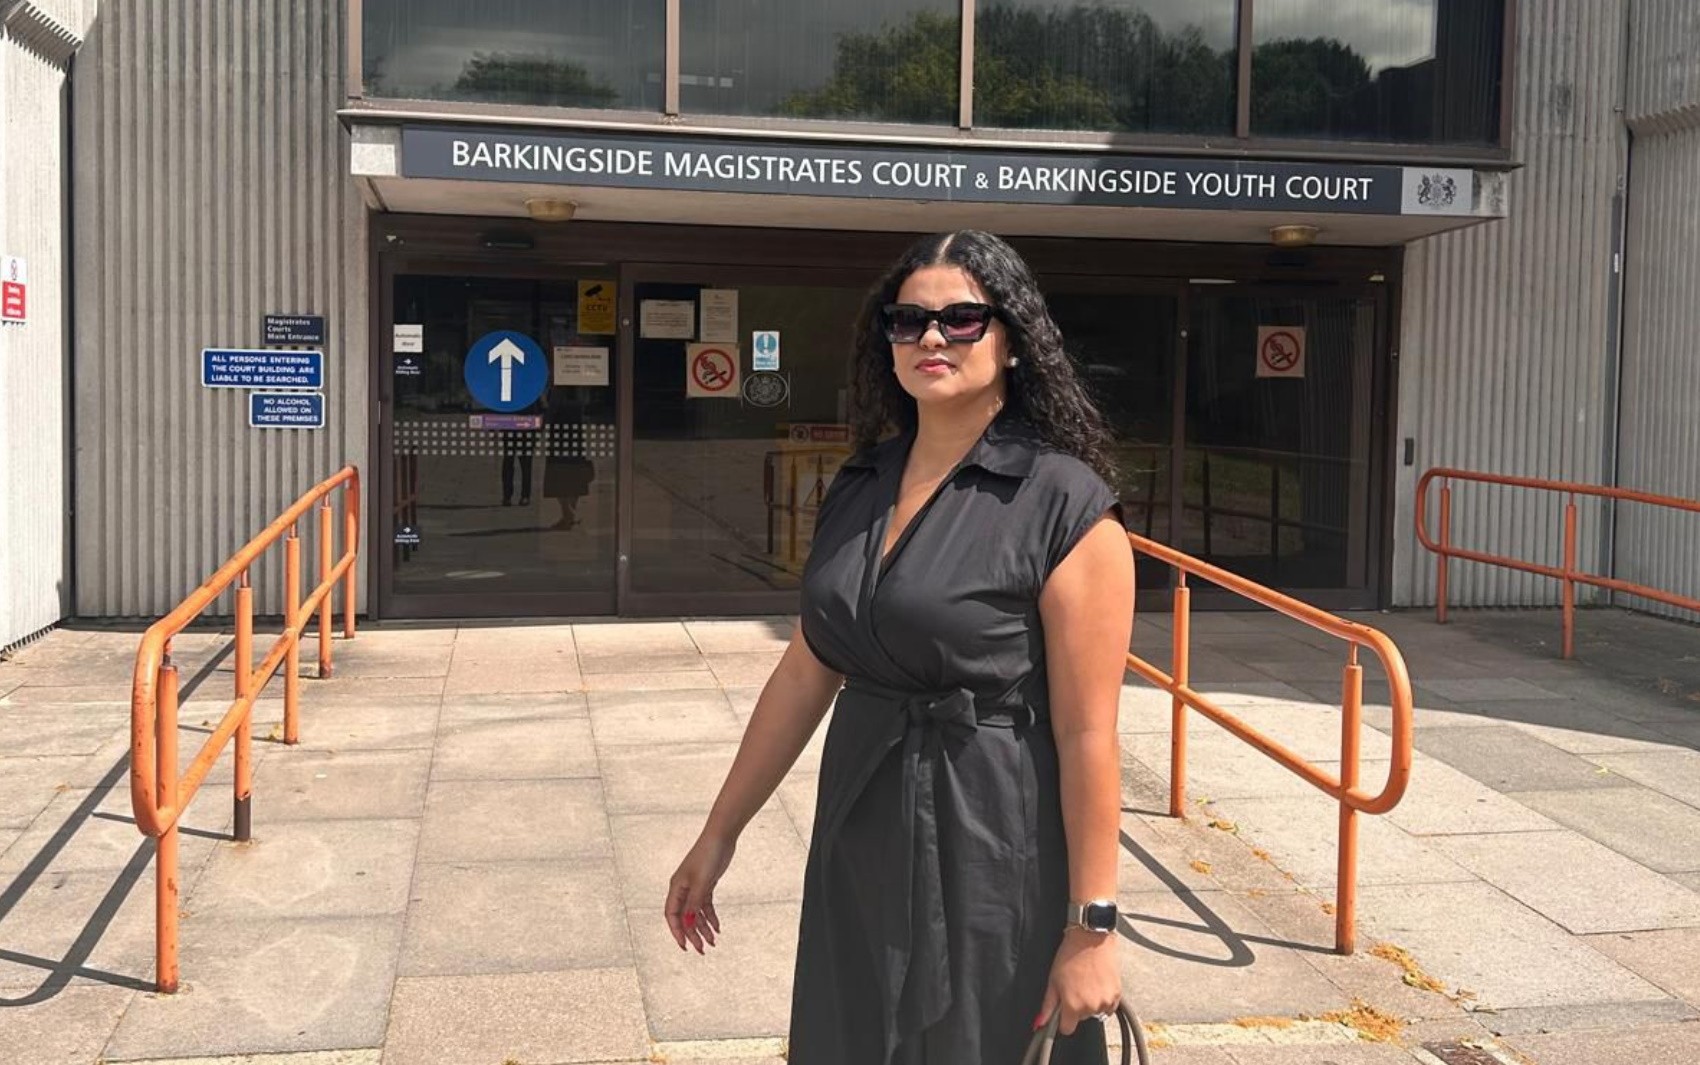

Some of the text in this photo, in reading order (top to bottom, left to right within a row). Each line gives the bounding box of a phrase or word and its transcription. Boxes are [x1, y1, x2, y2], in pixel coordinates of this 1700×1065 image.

[452, 140, 1373, 201] BARKINGSIDE MAGISTRATES COURT & BARKINGSIDE YOUTH COURT
[267, 318, 310, 326] Magistrates
[287, 333, 320, 341] Entrance
[211, 355, 311, 365] ALL PERSONS ENTERING
[212, 364, 227, 372] THE
[229, 365, 257, 373] COURT
[258, 366, 296, 374] BUILDING
[211, 374, 239, 382] LIABLE
[241, 375, 252, 383] TO
[253, 375, 265, 383] BE
[277, 398, 312, 406] ALCOHOL
[263, 406, 312, 414] ALLOWED ON
